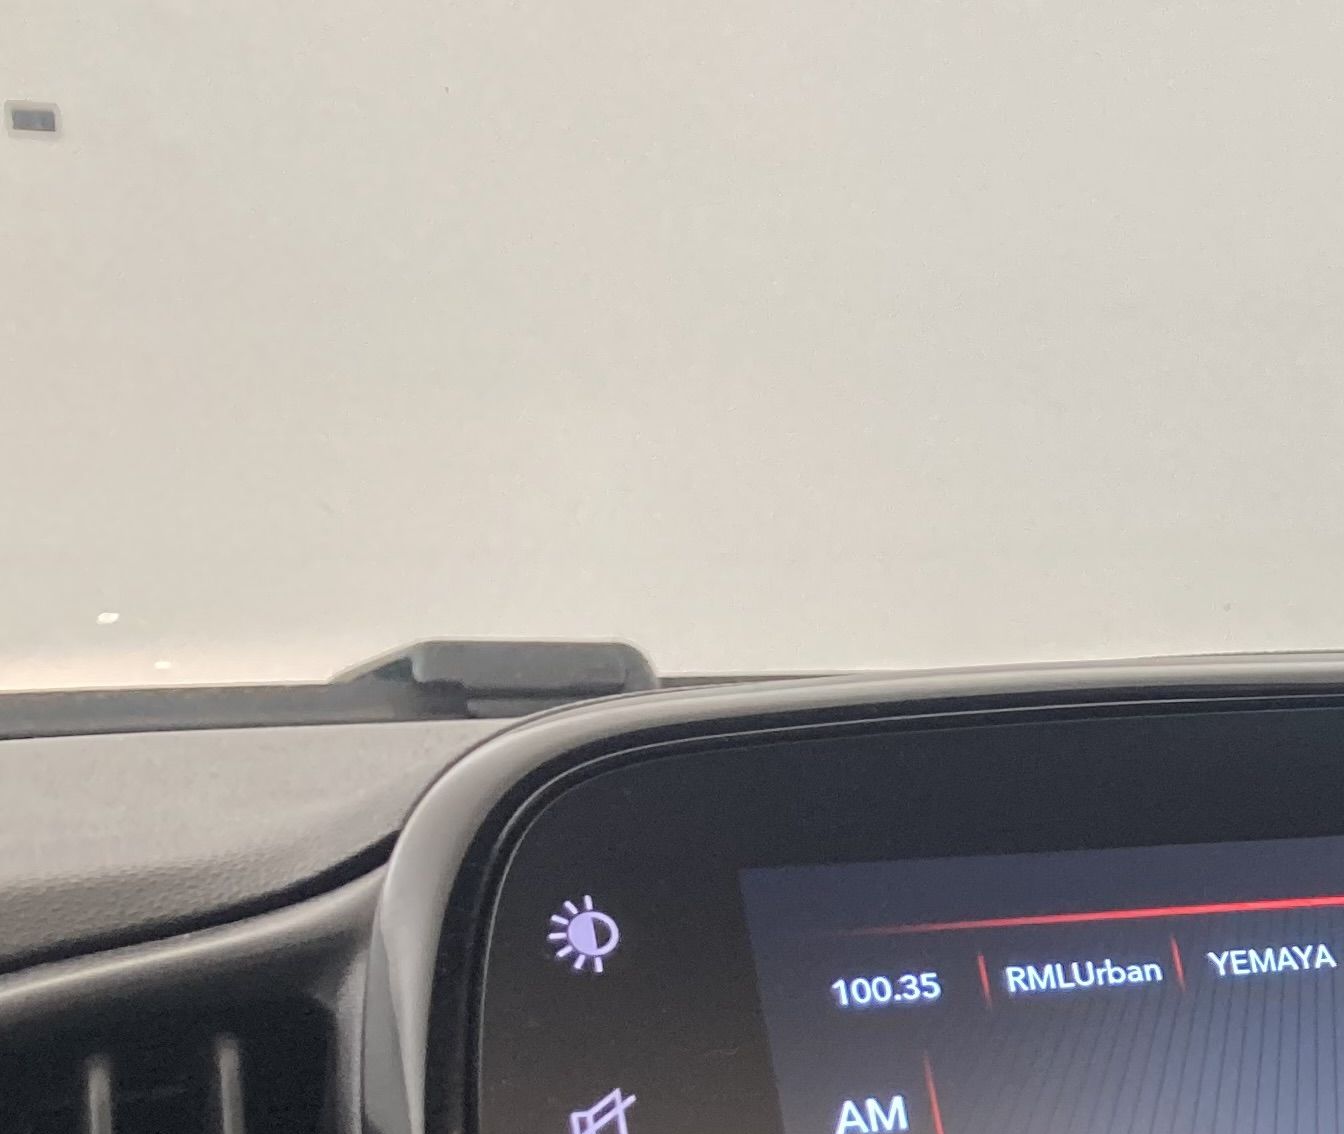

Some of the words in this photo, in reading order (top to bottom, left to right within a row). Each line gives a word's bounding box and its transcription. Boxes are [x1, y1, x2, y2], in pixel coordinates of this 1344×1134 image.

[1006, 958, 1162, 994] RMLUrban
[1208, 944, 1338, 978] YEMAYA
[831, 972, 942, 1008] 100.35
